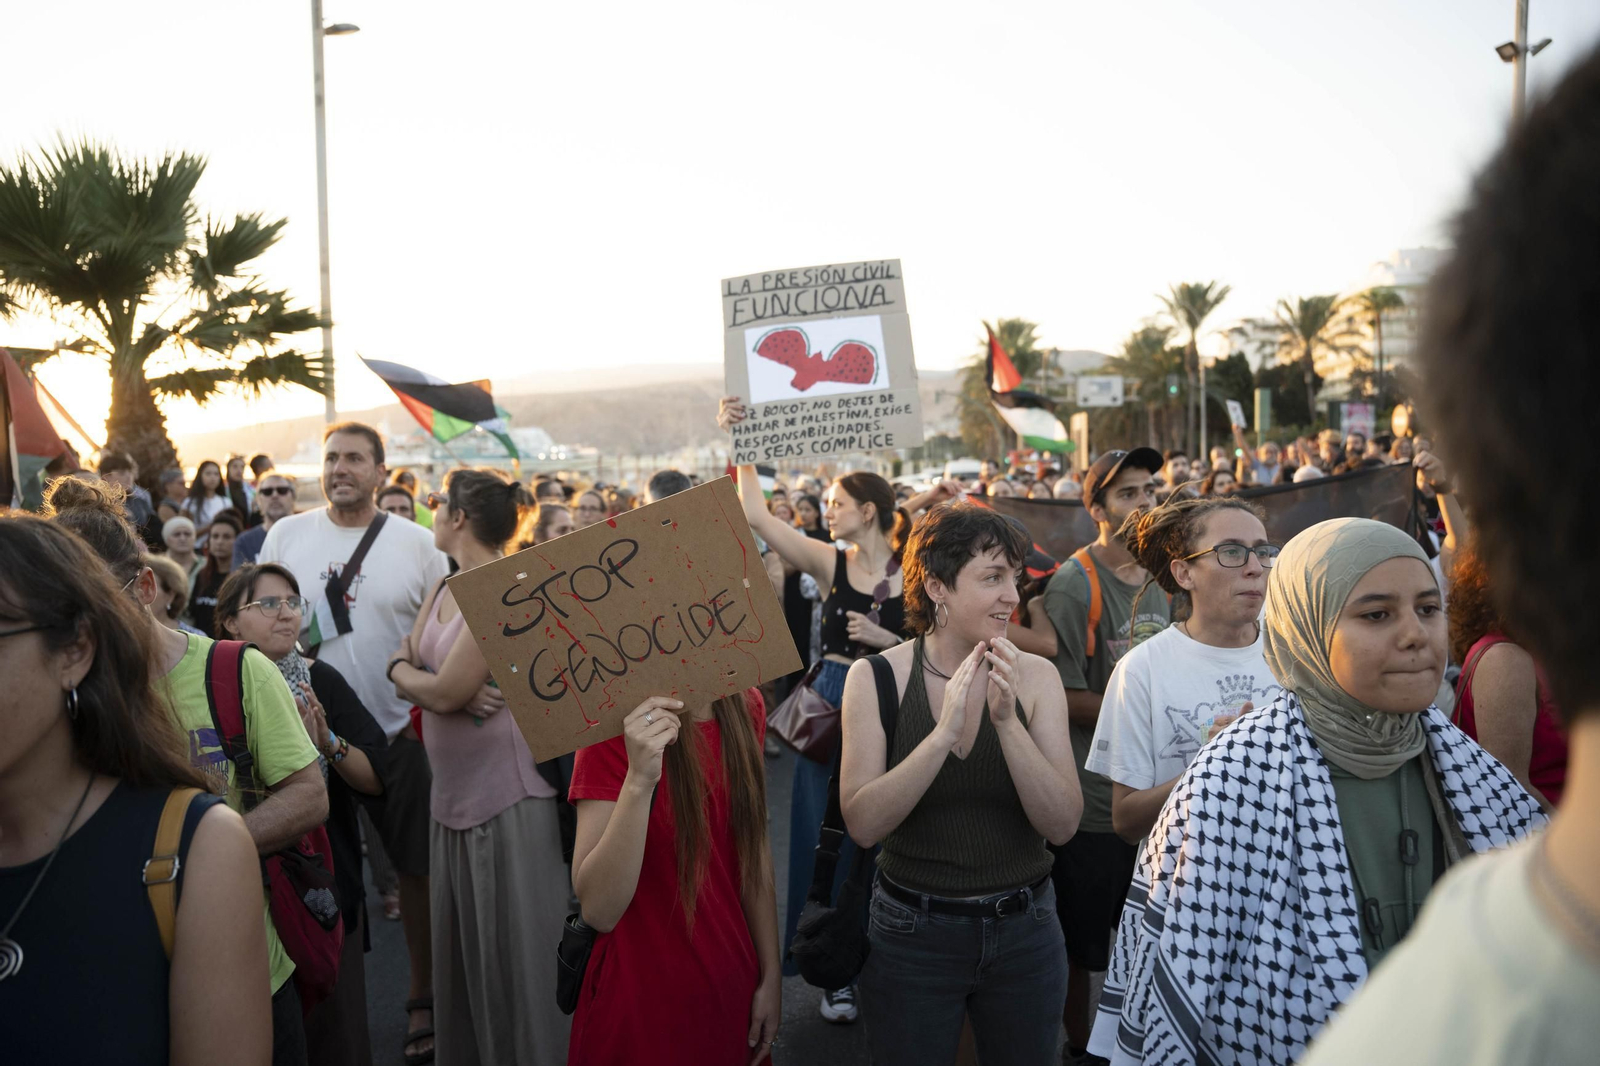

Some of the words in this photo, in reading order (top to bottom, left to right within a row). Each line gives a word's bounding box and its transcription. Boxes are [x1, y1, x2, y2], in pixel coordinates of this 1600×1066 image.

[726, 278, 752, 296] LA
[732, 284, 890, 327] FUNCIONA
[812, 399, 832, 411] NO
[837, 395, 874, 409] DEJES
[880, 393, 895, 404] DE
[732, 419, 780, 437] HABLAR
[784, 417, 797, 428] DE
[735, 450, 757, 464] NO
[764, 442, 805, 461] SEAS
[501, 538, 639, 637] STOP
